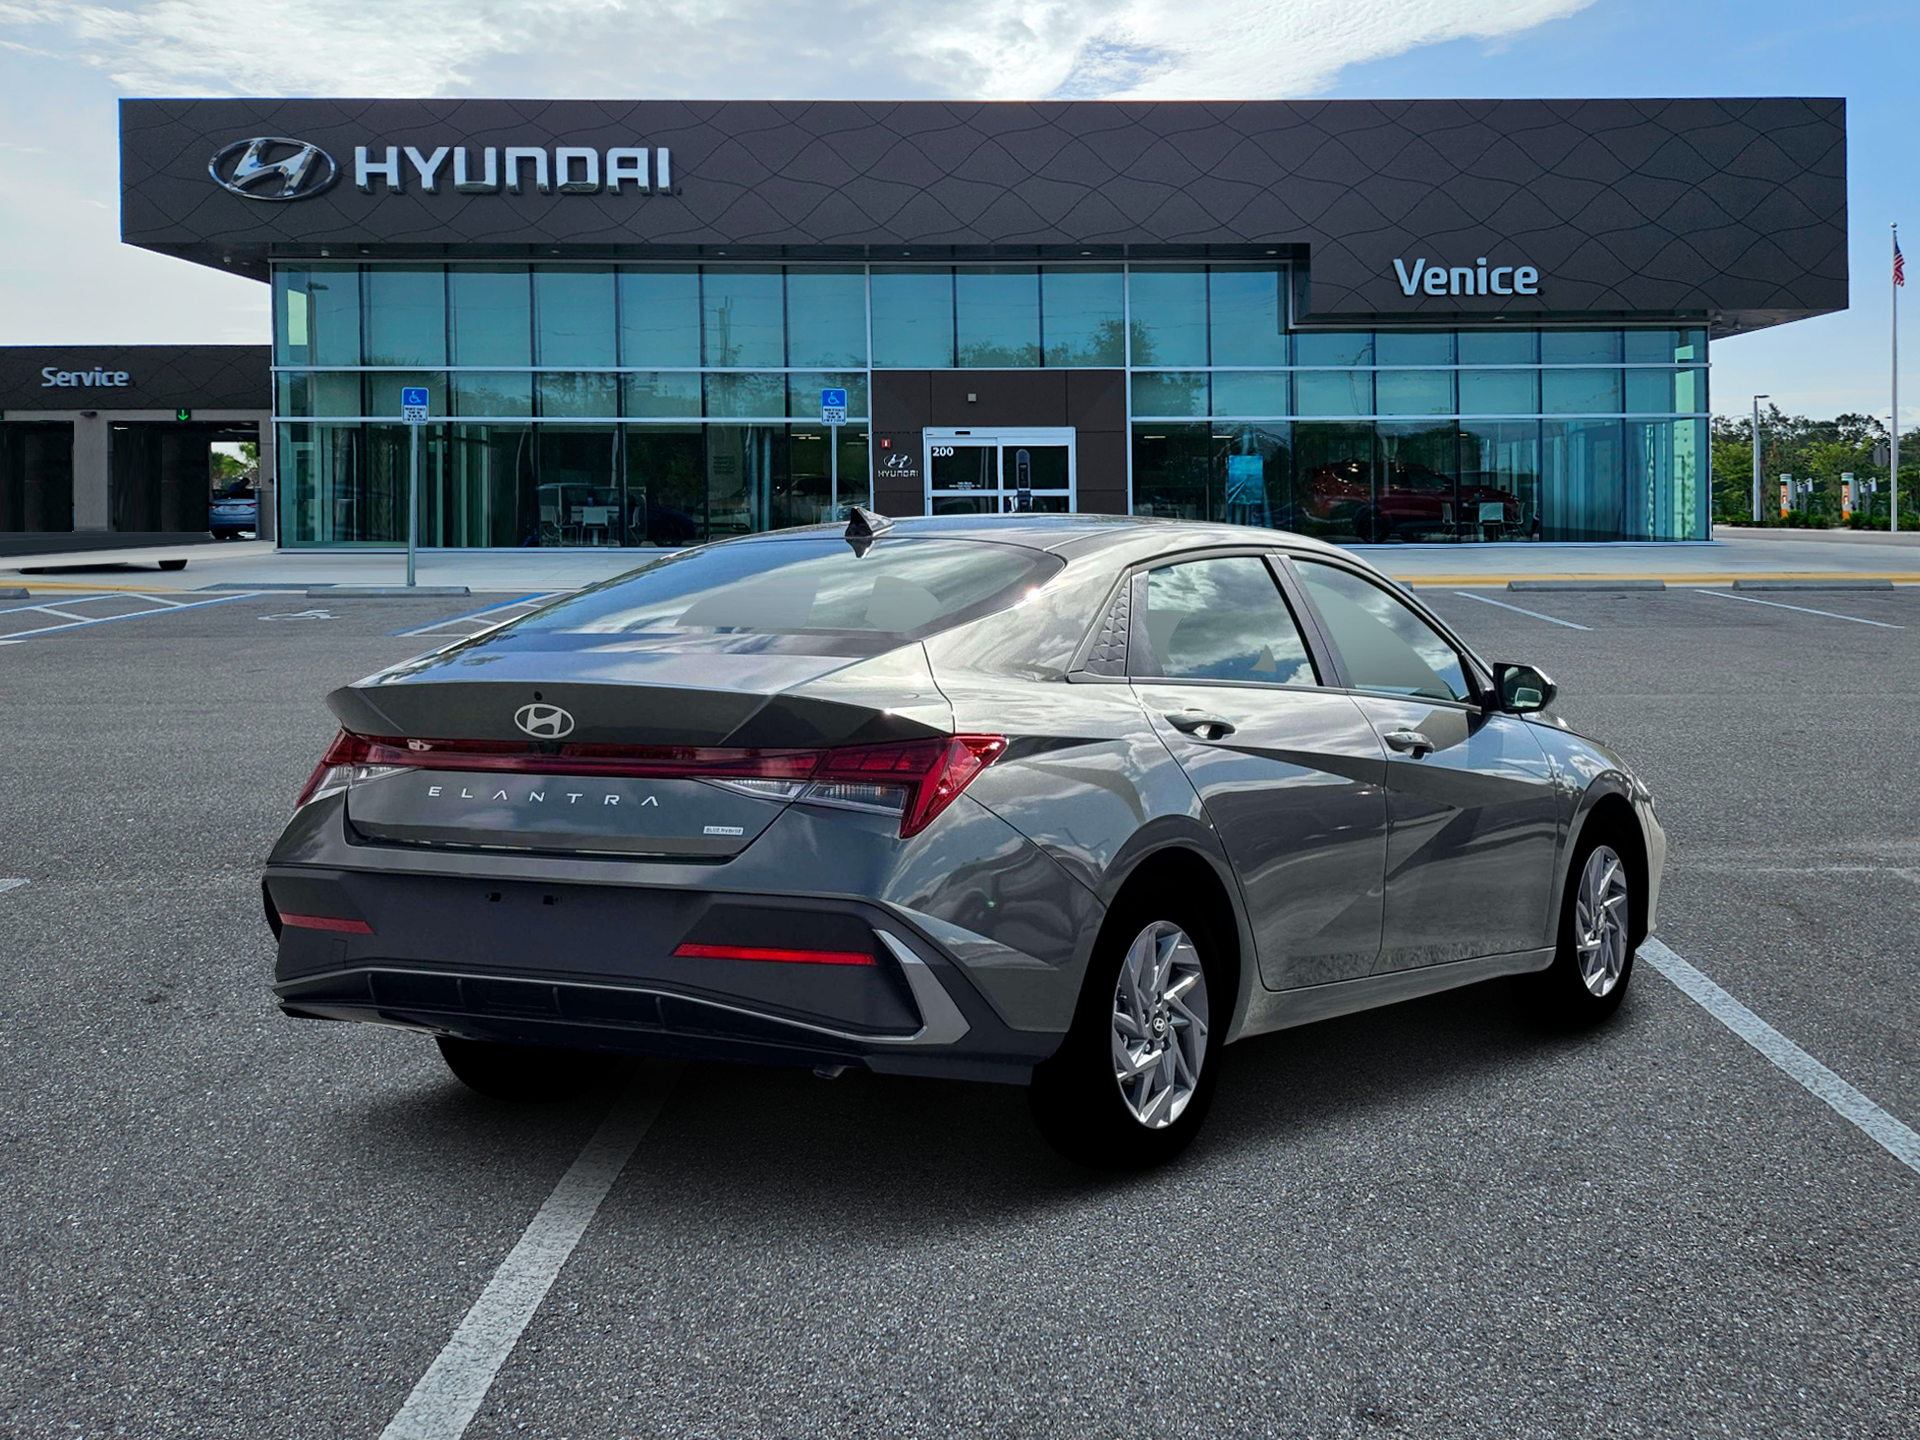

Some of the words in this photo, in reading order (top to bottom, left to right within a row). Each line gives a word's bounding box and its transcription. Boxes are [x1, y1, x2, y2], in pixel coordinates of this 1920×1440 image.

[355, 146, 672, 195] HYUNDAI
[1393, 257, 1538, 296] Venice
[41, 366, 130, 387] Service
[932, 446, 954, 457] 200
[877, 469, 919, 478] HYUNDAI
[428, 786, 660, 807] ELANTRA
